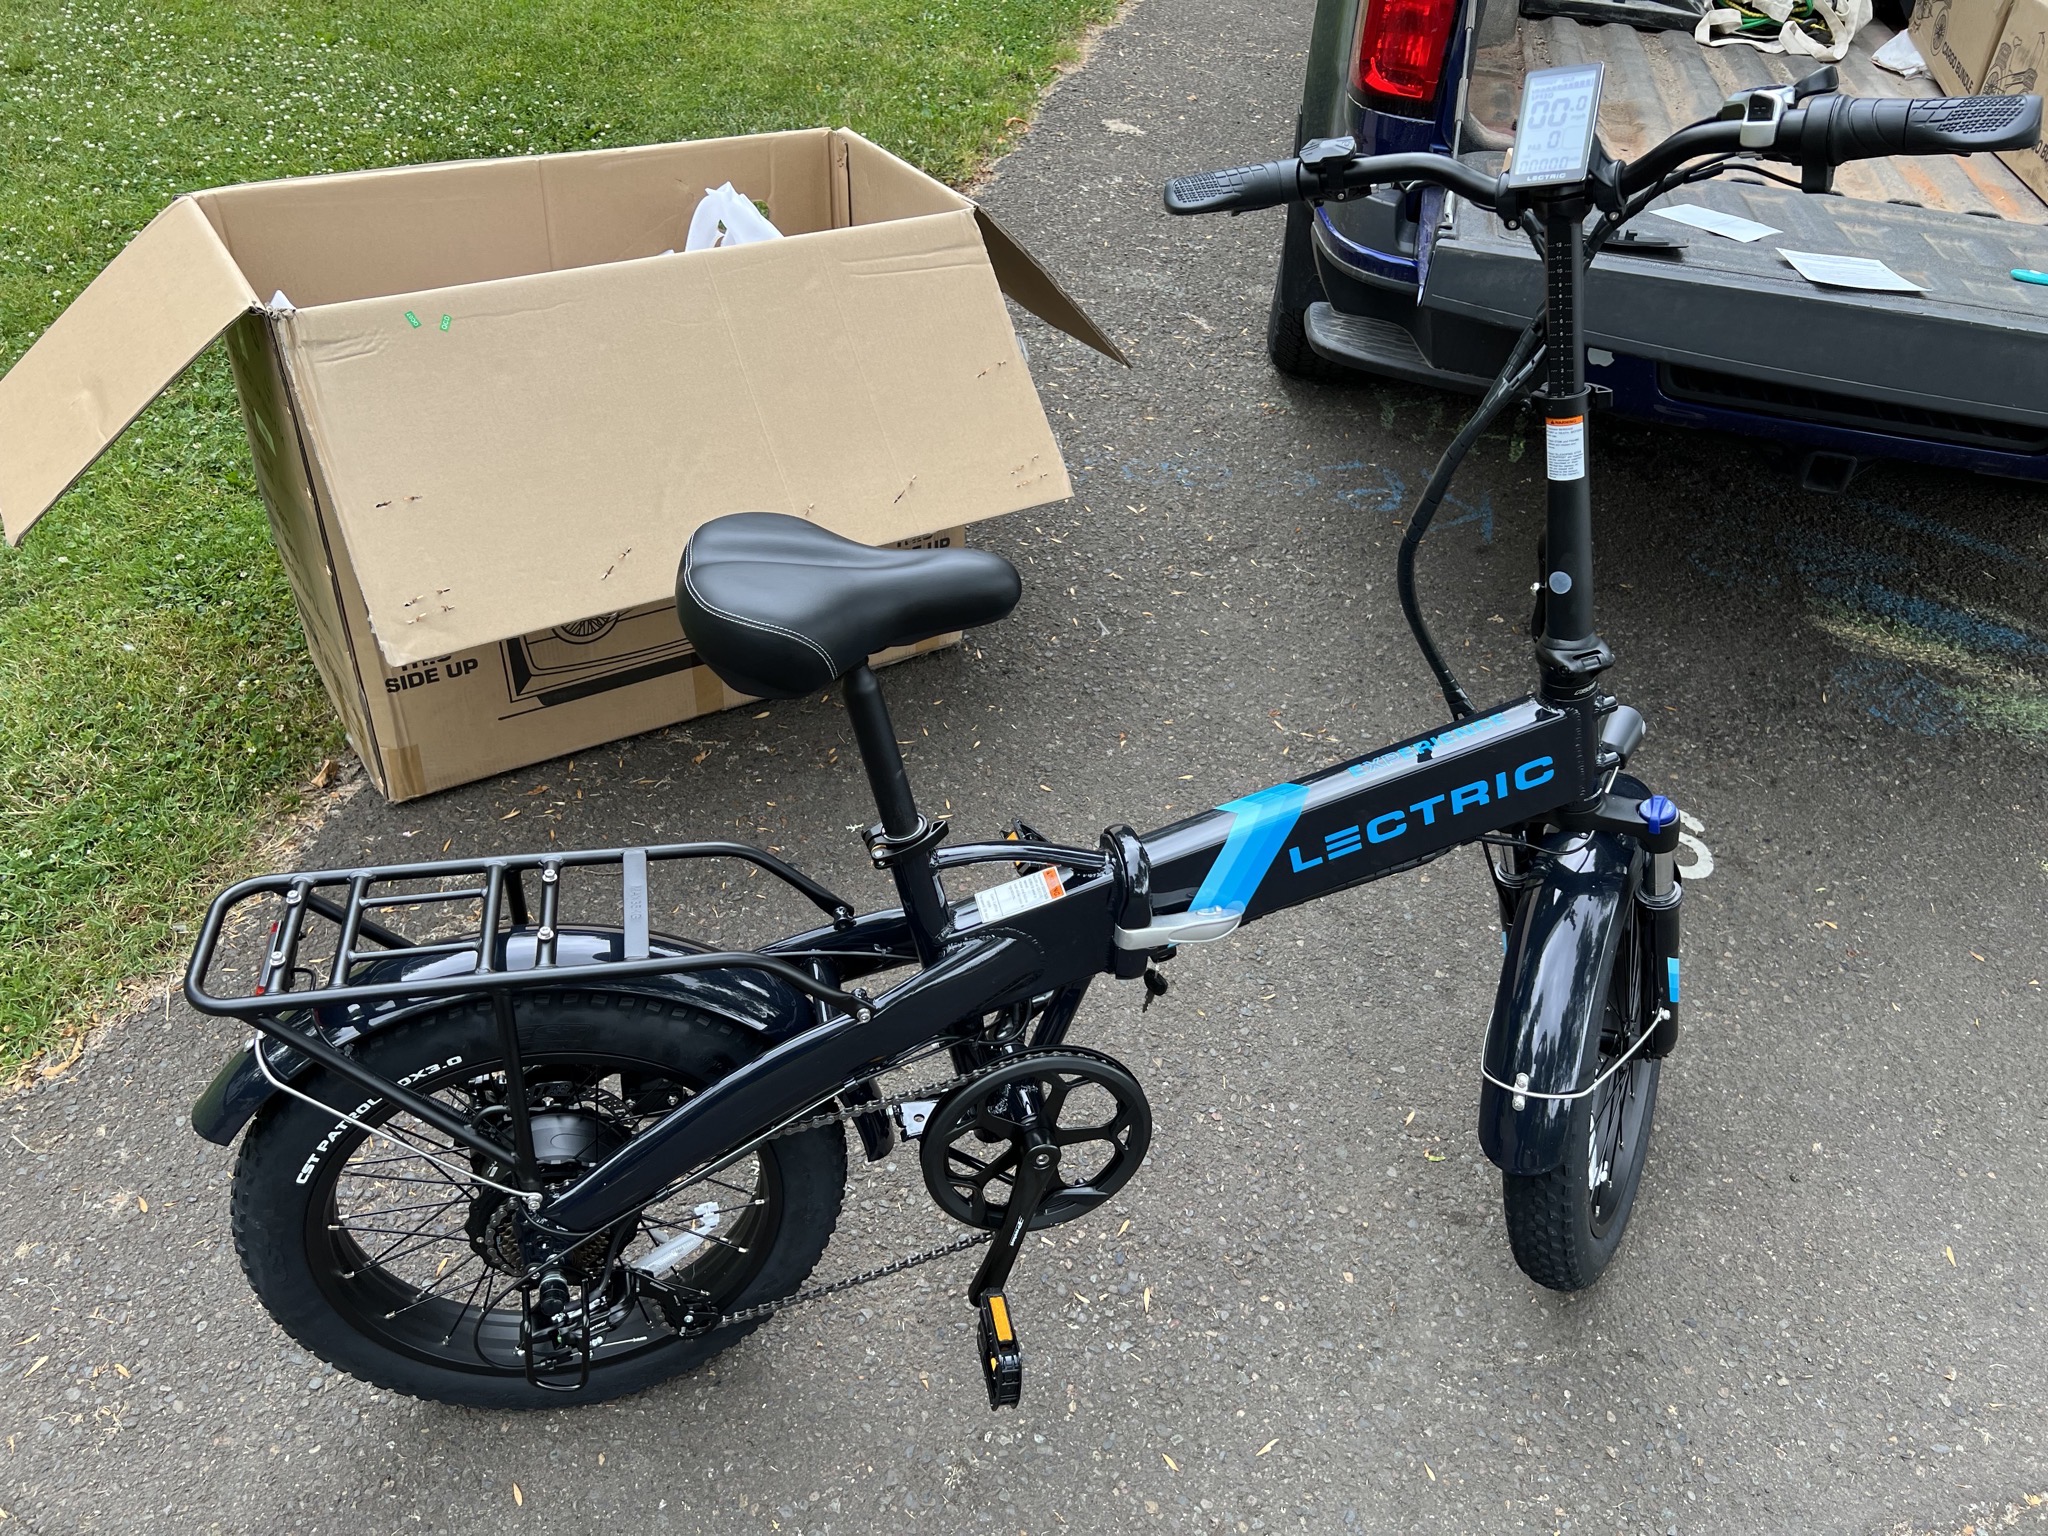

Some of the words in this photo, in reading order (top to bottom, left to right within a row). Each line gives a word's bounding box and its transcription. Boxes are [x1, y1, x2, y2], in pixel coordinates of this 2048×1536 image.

[1941, 41, 1957, 70] CARGO
[1954, 60, 1974, 94] BUNDLE
[1526, 172, 1567, 182] LECTRIC
[385, 667, 440, 693] SIDE
[445, 658, 479, 678] UP
[1348, 711, 1510, 778] EXPERIENCE
[1289, 755, 1555, 873] LECTRIC
[295, 1152, 321, 1185] CST
[316, 1096, 383, 1153] PATROL
